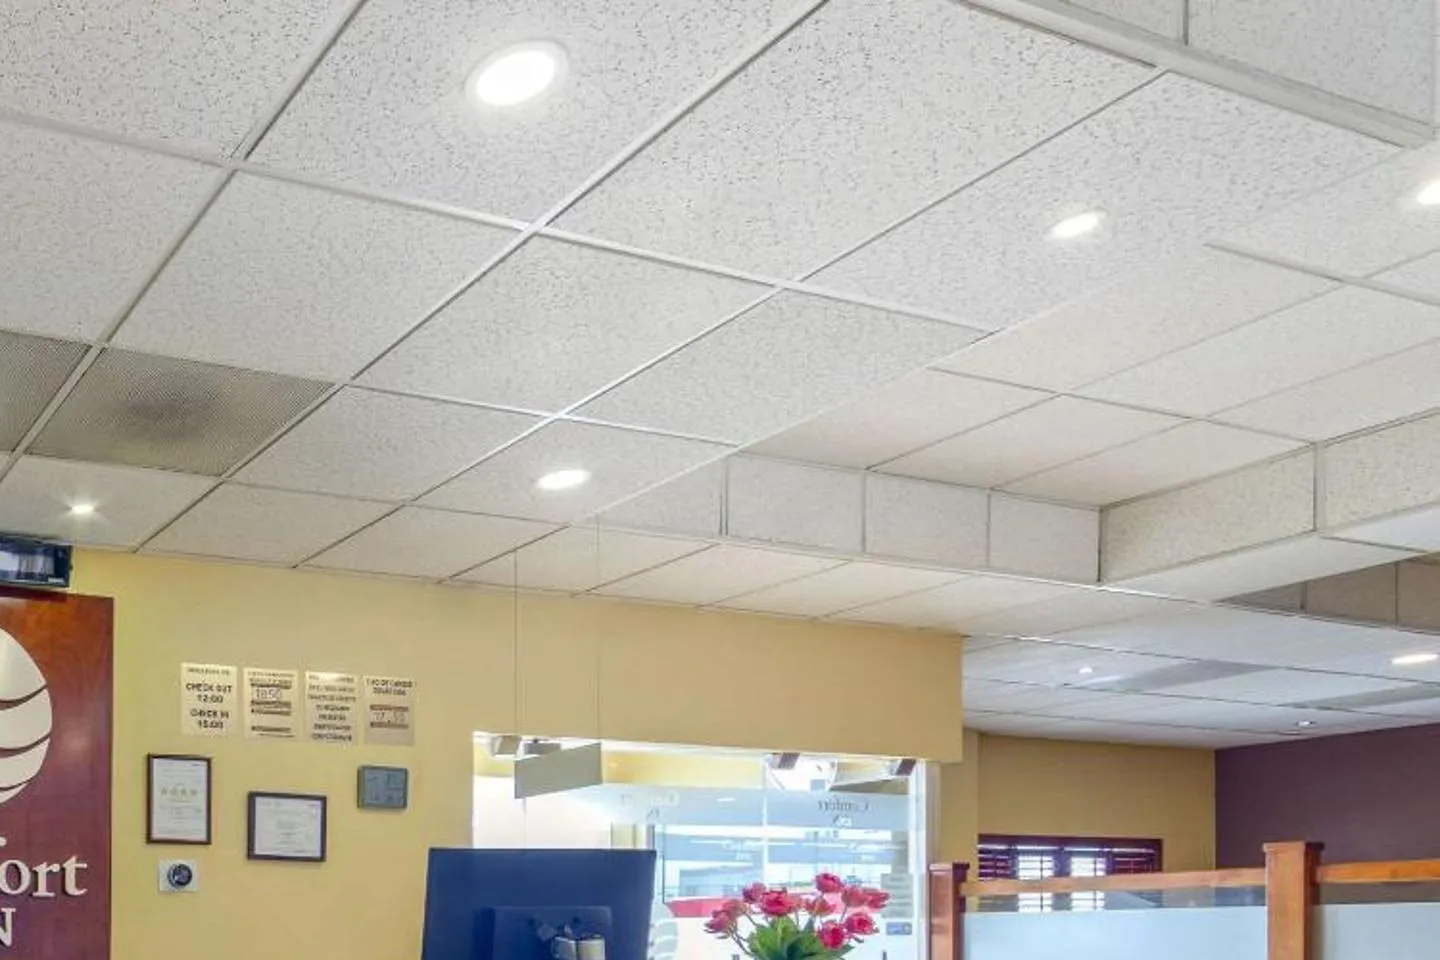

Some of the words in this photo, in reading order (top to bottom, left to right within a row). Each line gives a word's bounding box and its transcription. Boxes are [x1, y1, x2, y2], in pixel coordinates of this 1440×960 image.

[186, 682, 213, 692] CHECK
[216, 684, 232, 694] OUT
[197, 694, 224, 703] 12:00
[190, 708, 218, 717] CHECK
